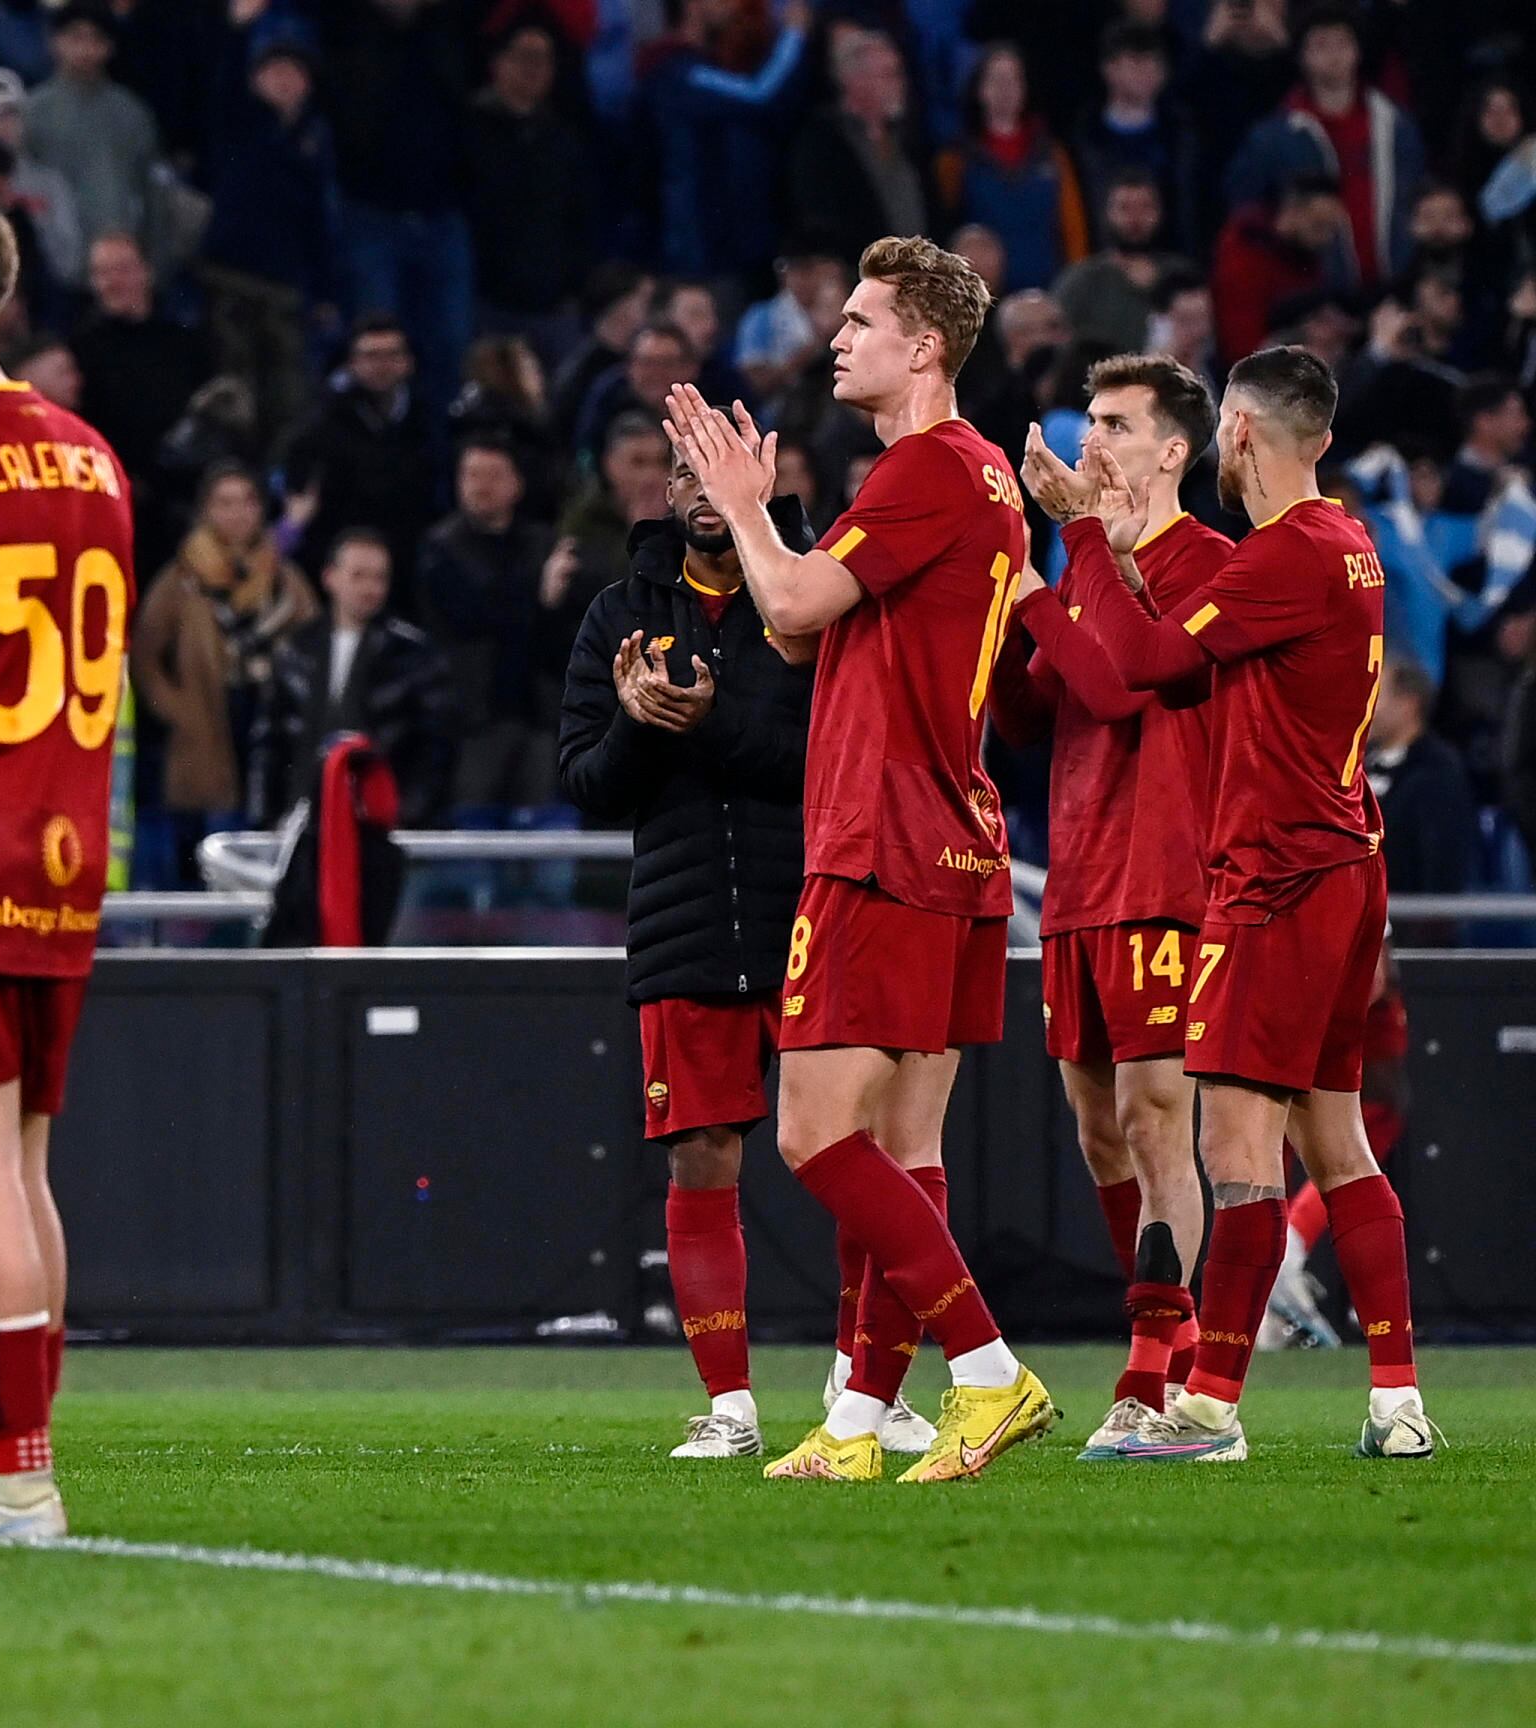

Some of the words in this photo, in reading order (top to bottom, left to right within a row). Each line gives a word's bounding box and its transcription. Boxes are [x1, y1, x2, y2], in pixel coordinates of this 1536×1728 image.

[1340, 634, 1384, 788] 7
[786, 914, 813, 981] 8
[1128, 928, 1185, 992] 14
[1188, 943, 1226, 1004] 7
